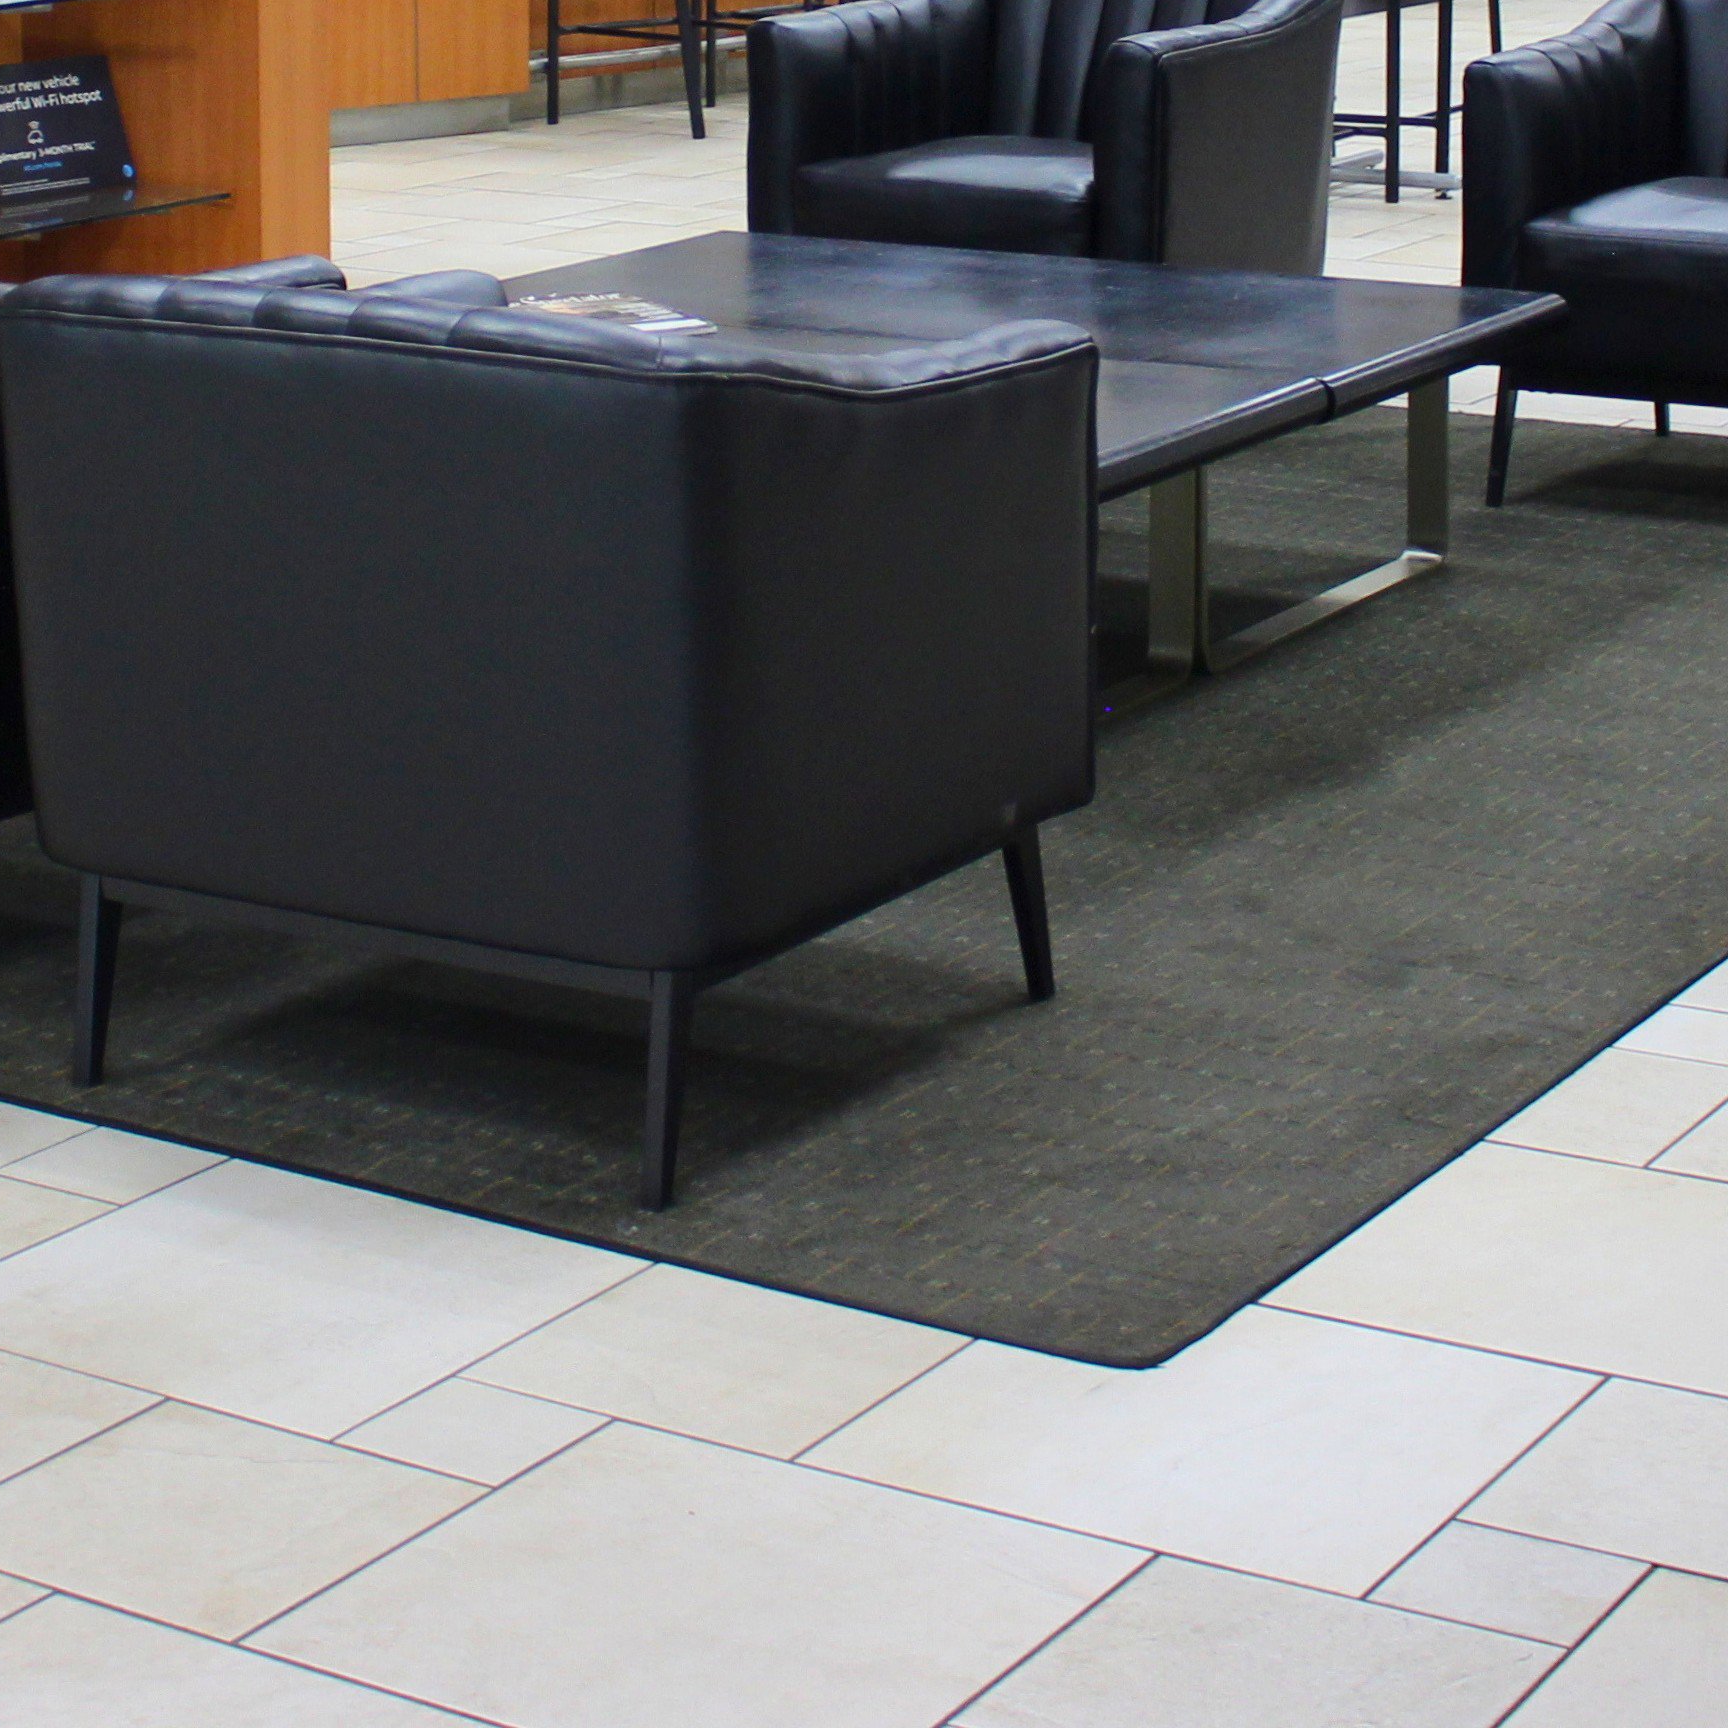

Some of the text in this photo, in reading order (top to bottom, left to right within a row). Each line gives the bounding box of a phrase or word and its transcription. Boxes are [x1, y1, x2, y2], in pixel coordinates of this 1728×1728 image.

[17, 80, 42, 93] new
[42, 73, 81, 90] vehicle
[31, 93, 60, 109] Wi-Fi
[60, 88, 103, 106] hotspot
